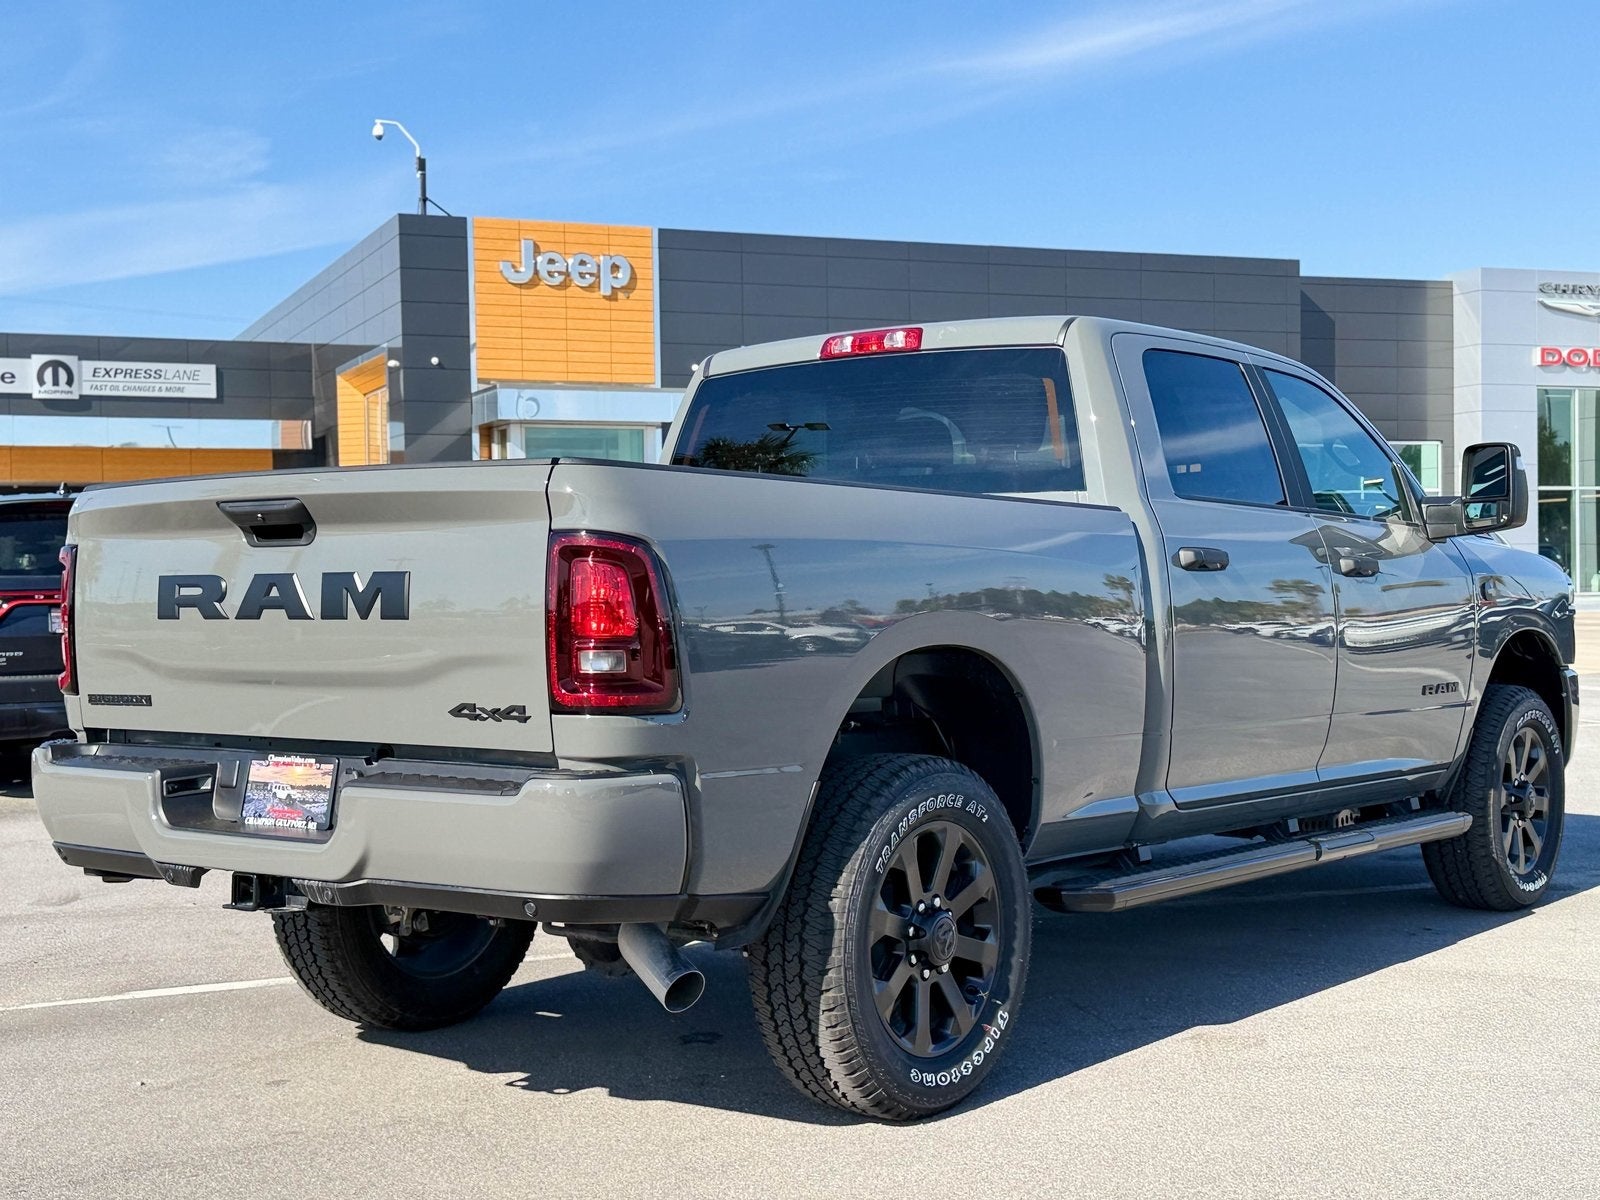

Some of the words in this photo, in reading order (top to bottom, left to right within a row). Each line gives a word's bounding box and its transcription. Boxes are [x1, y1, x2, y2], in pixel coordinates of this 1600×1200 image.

[500, 238, 631, 296] Jeep
[90, 384, 108, 392] FAST
[109, 384, 120, 392] OIL
[122, 385, 156, 393] CHANGES
[157, 571, 411, 621] RAM
[1421, 682, 1460, 696] RAM
[447, 702, 532, 723] 4x4
[875, 794, 964, 874] TRANSFORCE
